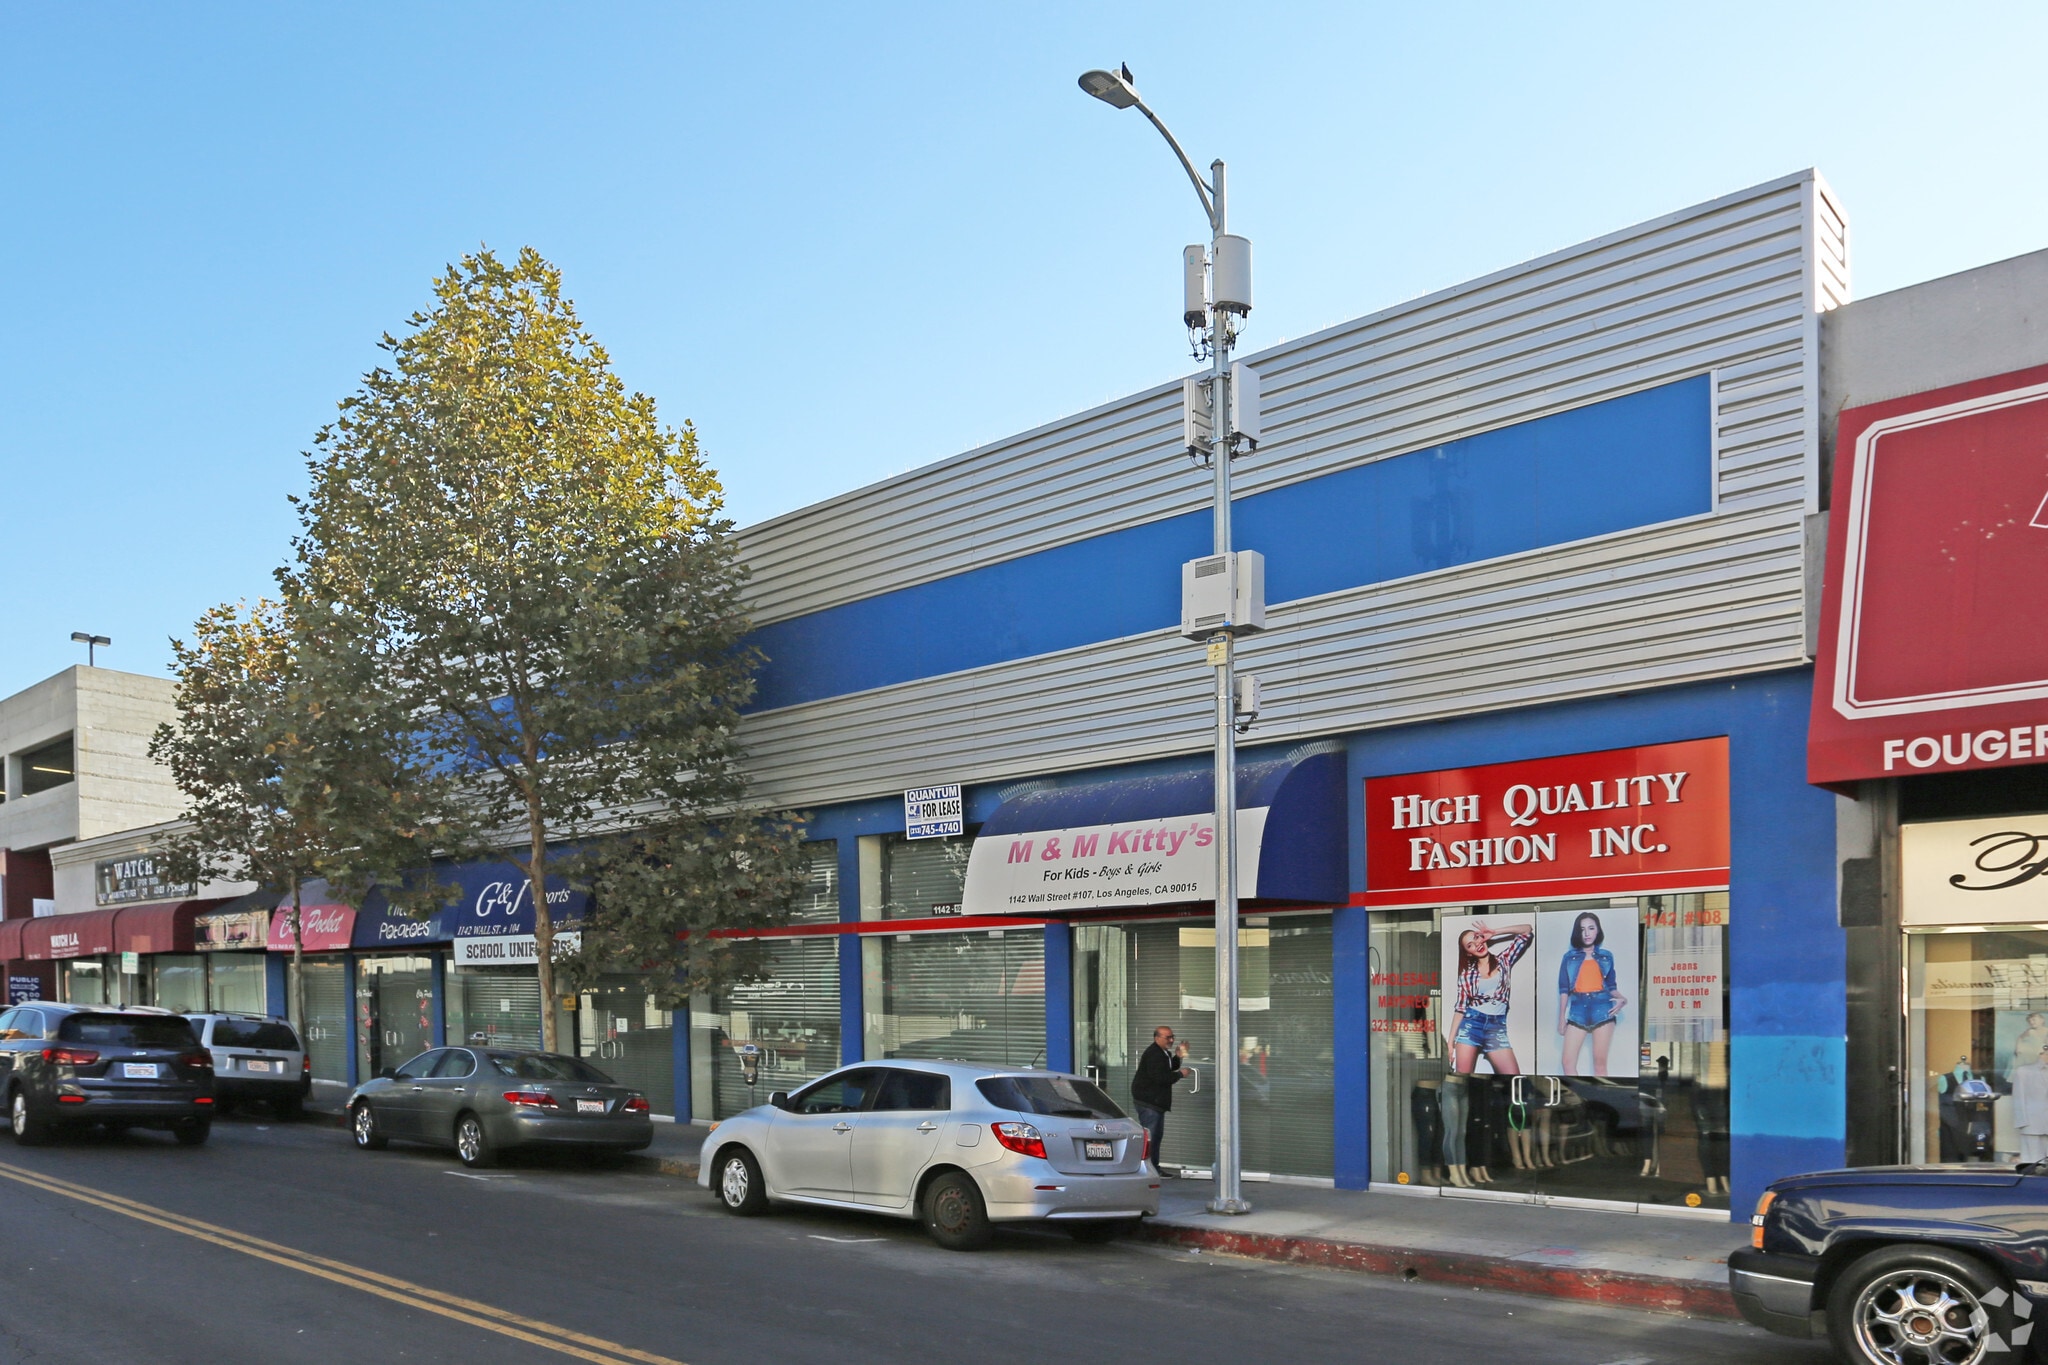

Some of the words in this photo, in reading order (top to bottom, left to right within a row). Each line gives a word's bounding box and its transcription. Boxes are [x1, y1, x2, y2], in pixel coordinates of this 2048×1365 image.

[909, 785, 957, 802] QUANTUM
[1392, 795, 1480, 830] HIGH
[1503, 772, 1689, 826] QUALITY
[922, 803, 937, 818] FOR
[939, 800, 960, 816] LEASE
[1007, 840, 1034, 864] M
[1041, 837, 1062, 861] &
[1072, 834, 1100, 858] M
[1107, 822, 1214, 857] Kitty's
[1408, 833, 1557, 871] FASHION
[1589, 824, 1669, 857] INC.
[114, 860, 153, 880] WATCH
[1043, 870, 1062, 881] For
[1064, 867, 1090, 880] Kids
[1098, 865, 1122, 880] Boys
[1137, 861, 1162, 877] Girls
[1009, 894, 1027, 904] 1142
[1028, 893, 1045, 902] Wall
[1046, 891, 1071, 902] Street
[1096, 888, 1112, 898] Los
[1114, 886, 1152, 898] Angeles,
[1154, 884, 1168, 894] CA
[1170, 882, 1198, 893] 90015
[1644, 911, 1677, 926] 1142
[1684, 910, 1722, 925] #108
[457, 926, 472, 936] 1142
[466, 943, 506, 959] SCHOOL
[1670, 962, 1698, 971] Jeans
[1372, 971, 1439, 986] WHOLESALE
[1378, 995, 1431, 1008] MAYOREO
